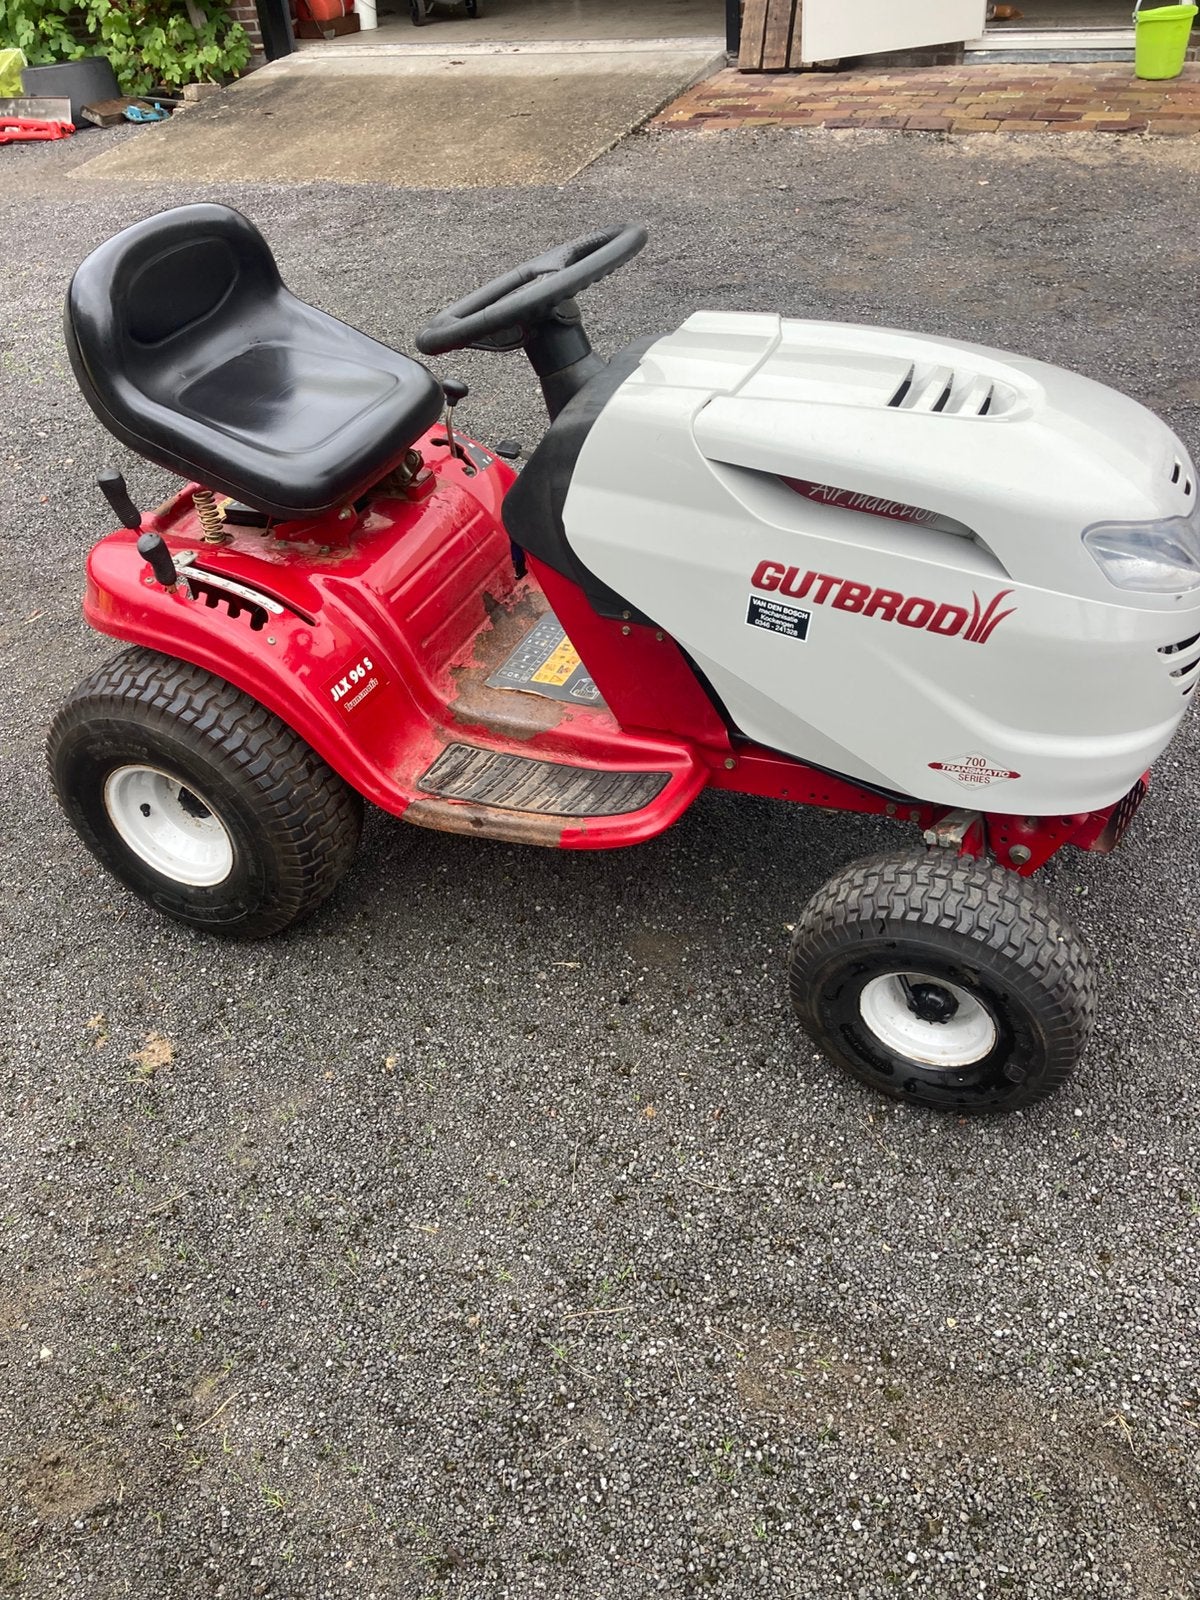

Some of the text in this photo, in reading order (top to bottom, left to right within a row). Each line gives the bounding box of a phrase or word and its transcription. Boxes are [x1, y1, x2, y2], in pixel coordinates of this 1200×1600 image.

[808, 484, 846, 501] Air
[750, 559, 969, 637] GUTBROD
[752, 598, 808, 620] VAN DEN BOSCH
[758, 607, 798, 624] mechanisatie
[754, 618, 770, 629] 0346
[330, 656, 373, 702] JLX 96 S
[965, 756, 987, 767] 700
[941, 763, 1011, 778] TRANSMATIC
[958, 773, 991, 784] SERIES
